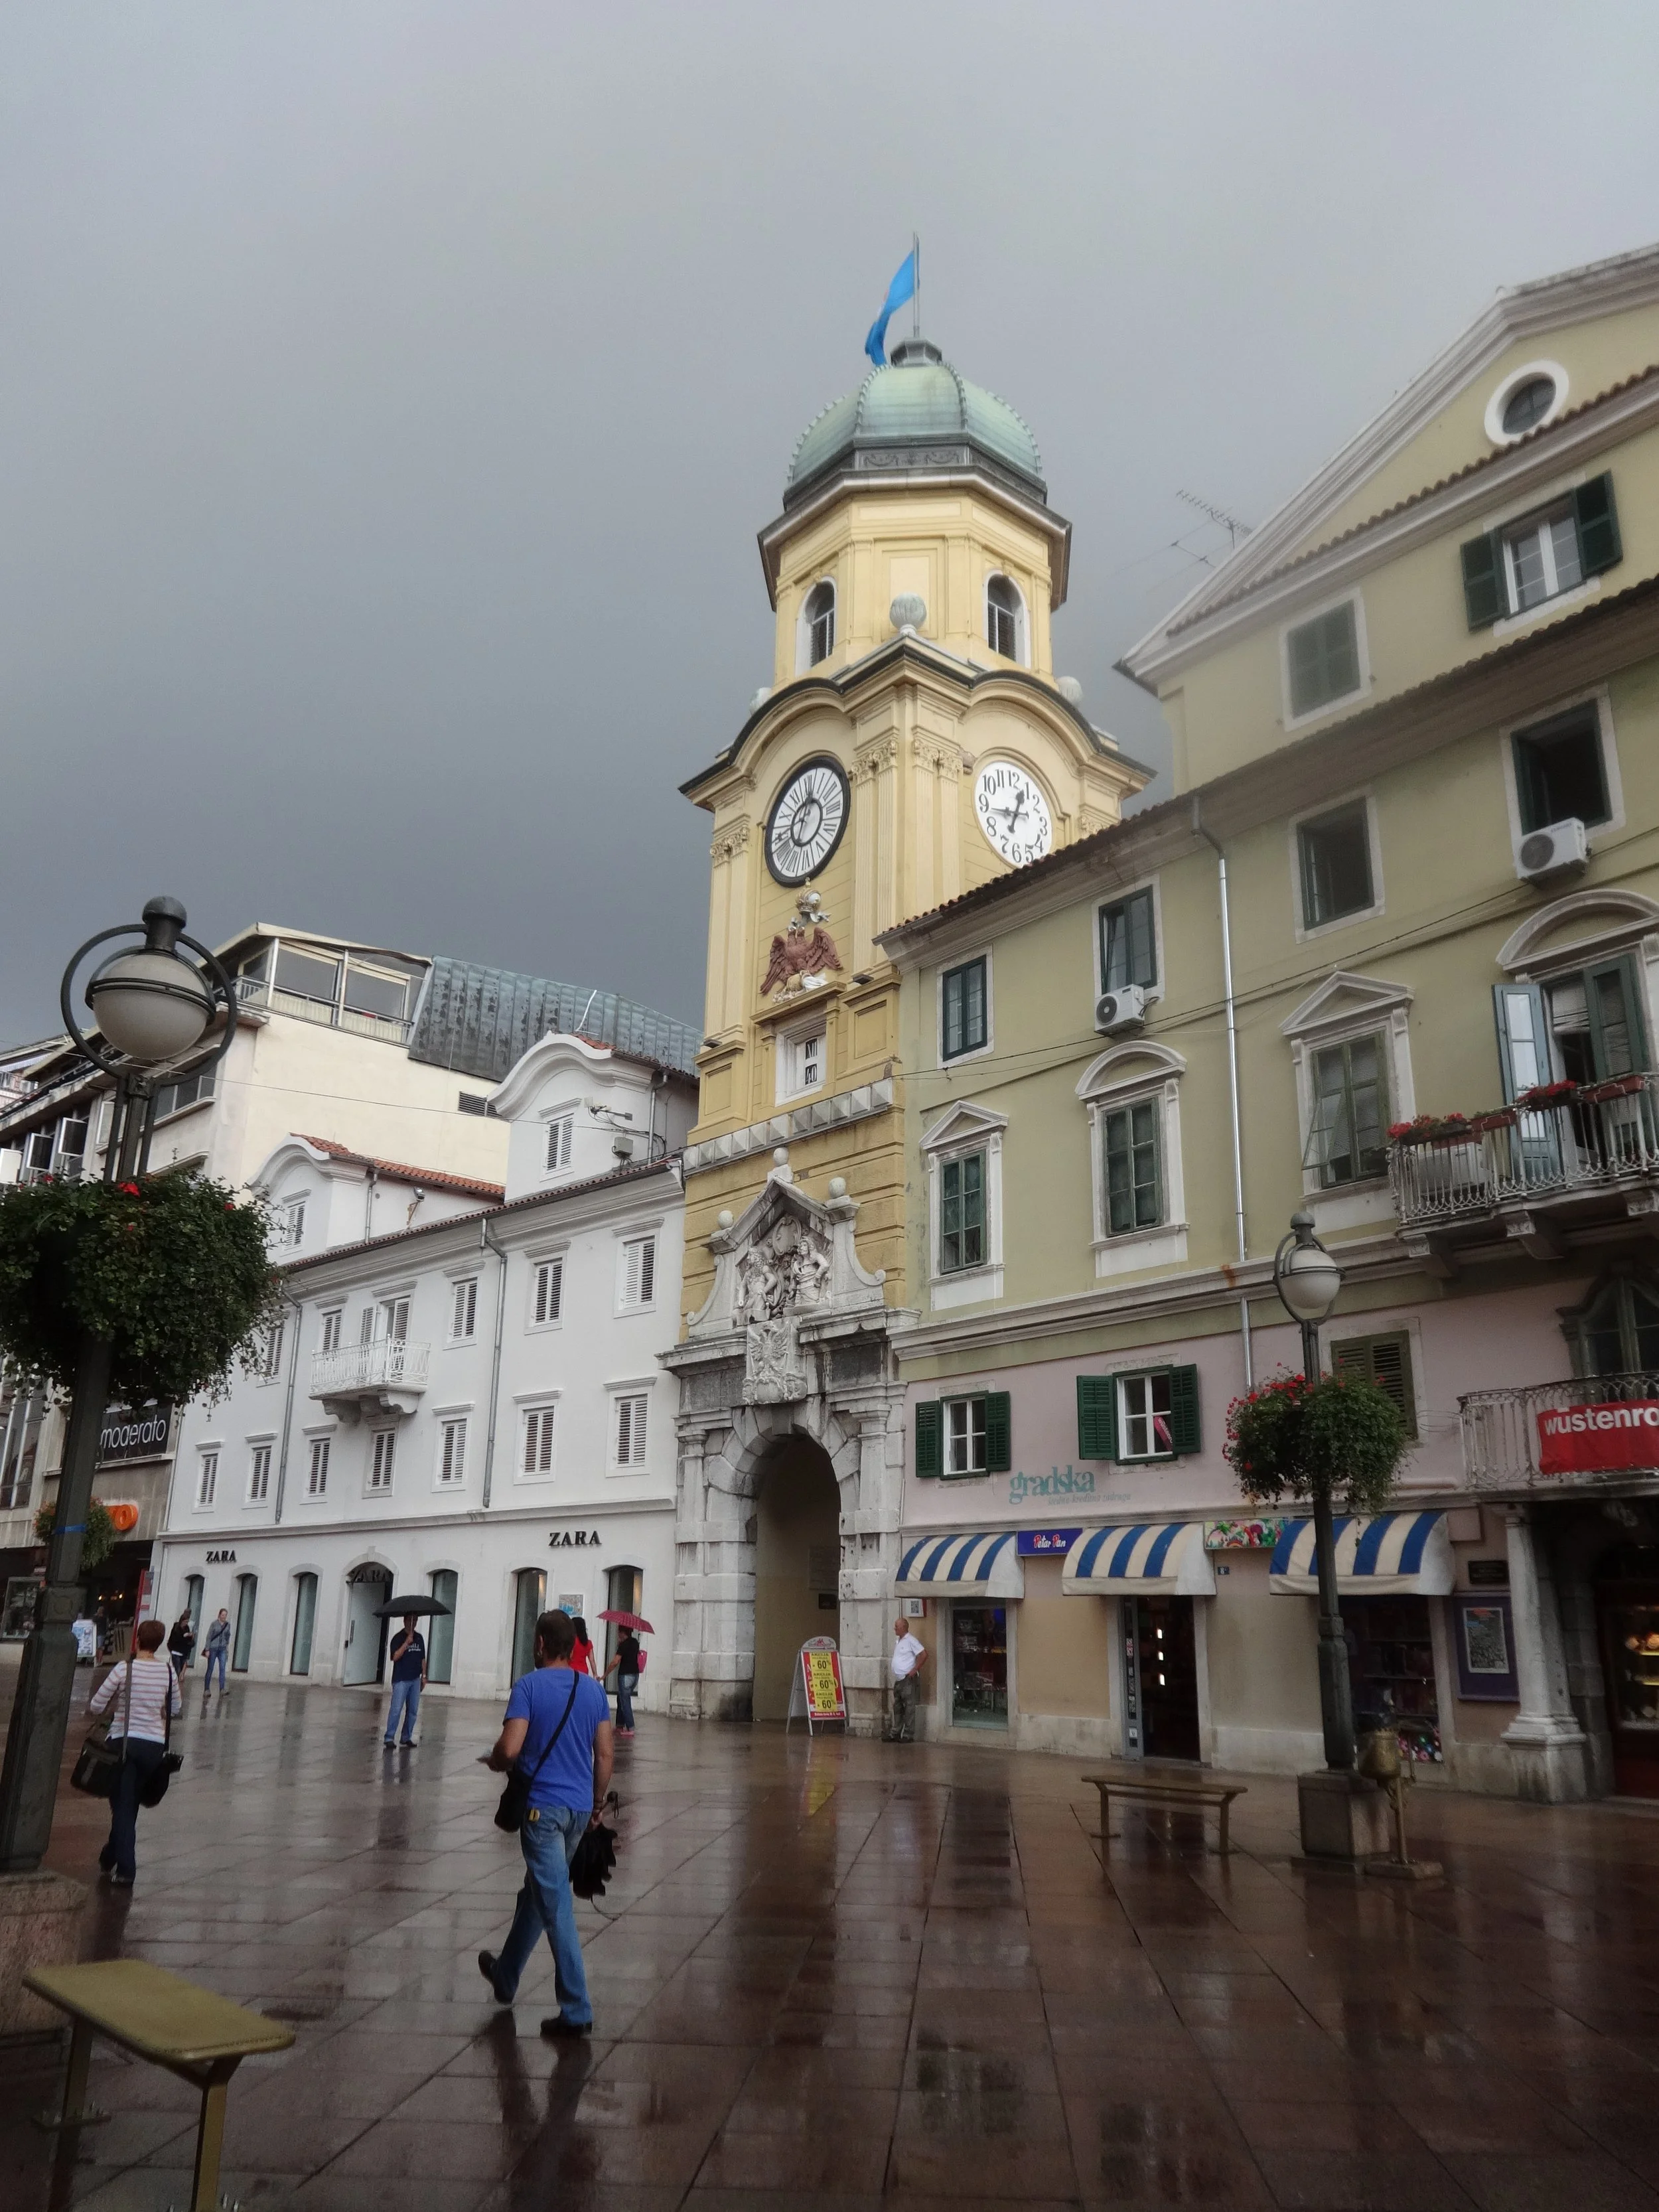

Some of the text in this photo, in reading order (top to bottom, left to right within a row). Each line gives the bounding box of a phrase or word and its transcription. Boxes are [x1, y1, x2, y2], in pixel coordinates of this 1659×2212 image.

[982, 774, 997, 796] 10
[995, 769, 1005, 788] 11
[1007, 770, 1020, 790] 12
[1024, 782, 1030, 800] 1
[978, 793, 990, 813] 9
[1032, 794, 1041, 814] 2
[985, 816, 997, 838] 8
[1039, 816, 1048, 836] 3
[999, 833, 1010, 854] 7
[1011, 842, 1022, 863] 6
[1024, 844, 1034, 863] 5
[1034, 833, 1044, 854] 4
[806, 1065, 817, 1084] 40
[1009, 1465, 1096, 1505] gradska
[548, 1530, 603, 1546] ZARA
[1033, 1534, 1066, 1548] Petar Pan
[206, 1550, 237, 1562] ZARA
